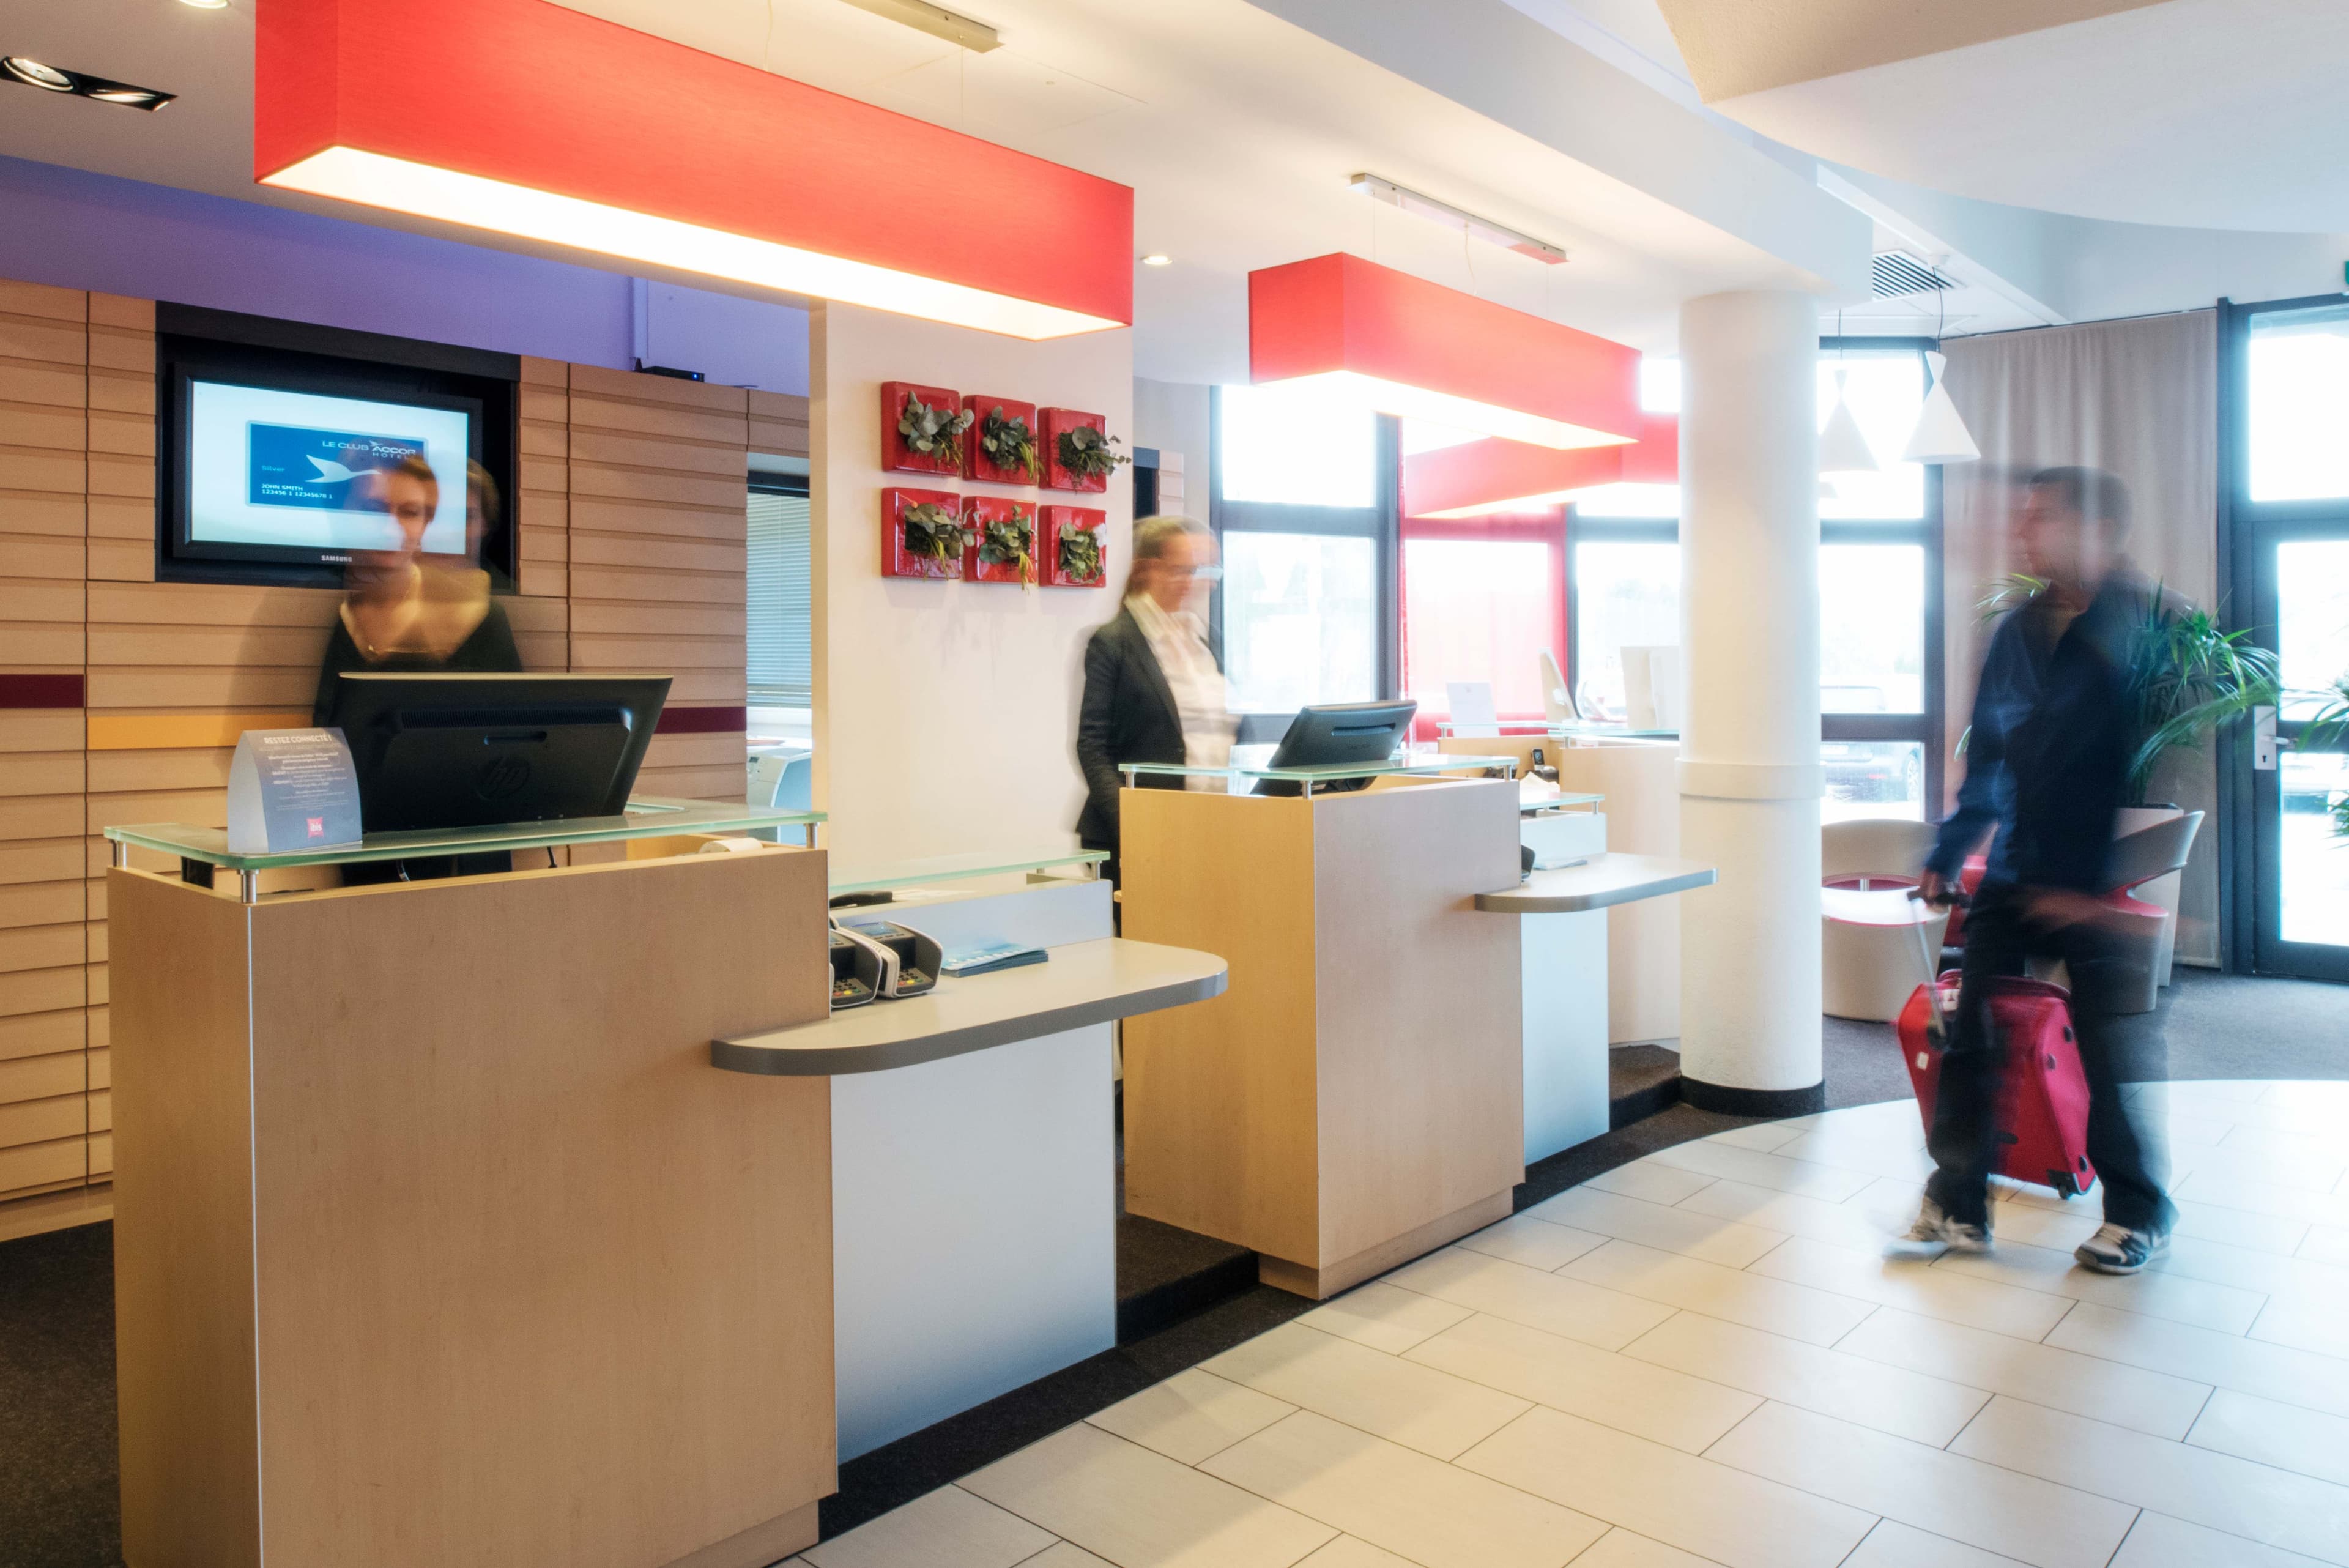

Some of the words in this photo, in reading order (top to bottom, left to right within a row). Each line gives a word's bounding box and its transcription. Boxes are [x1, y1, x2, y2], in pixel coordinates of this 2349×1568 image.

[337, 442, 369, 451] CLUB
[372, 446, 416, 455] ACCOR
[264, 736, 291, 745] RESTEZ
